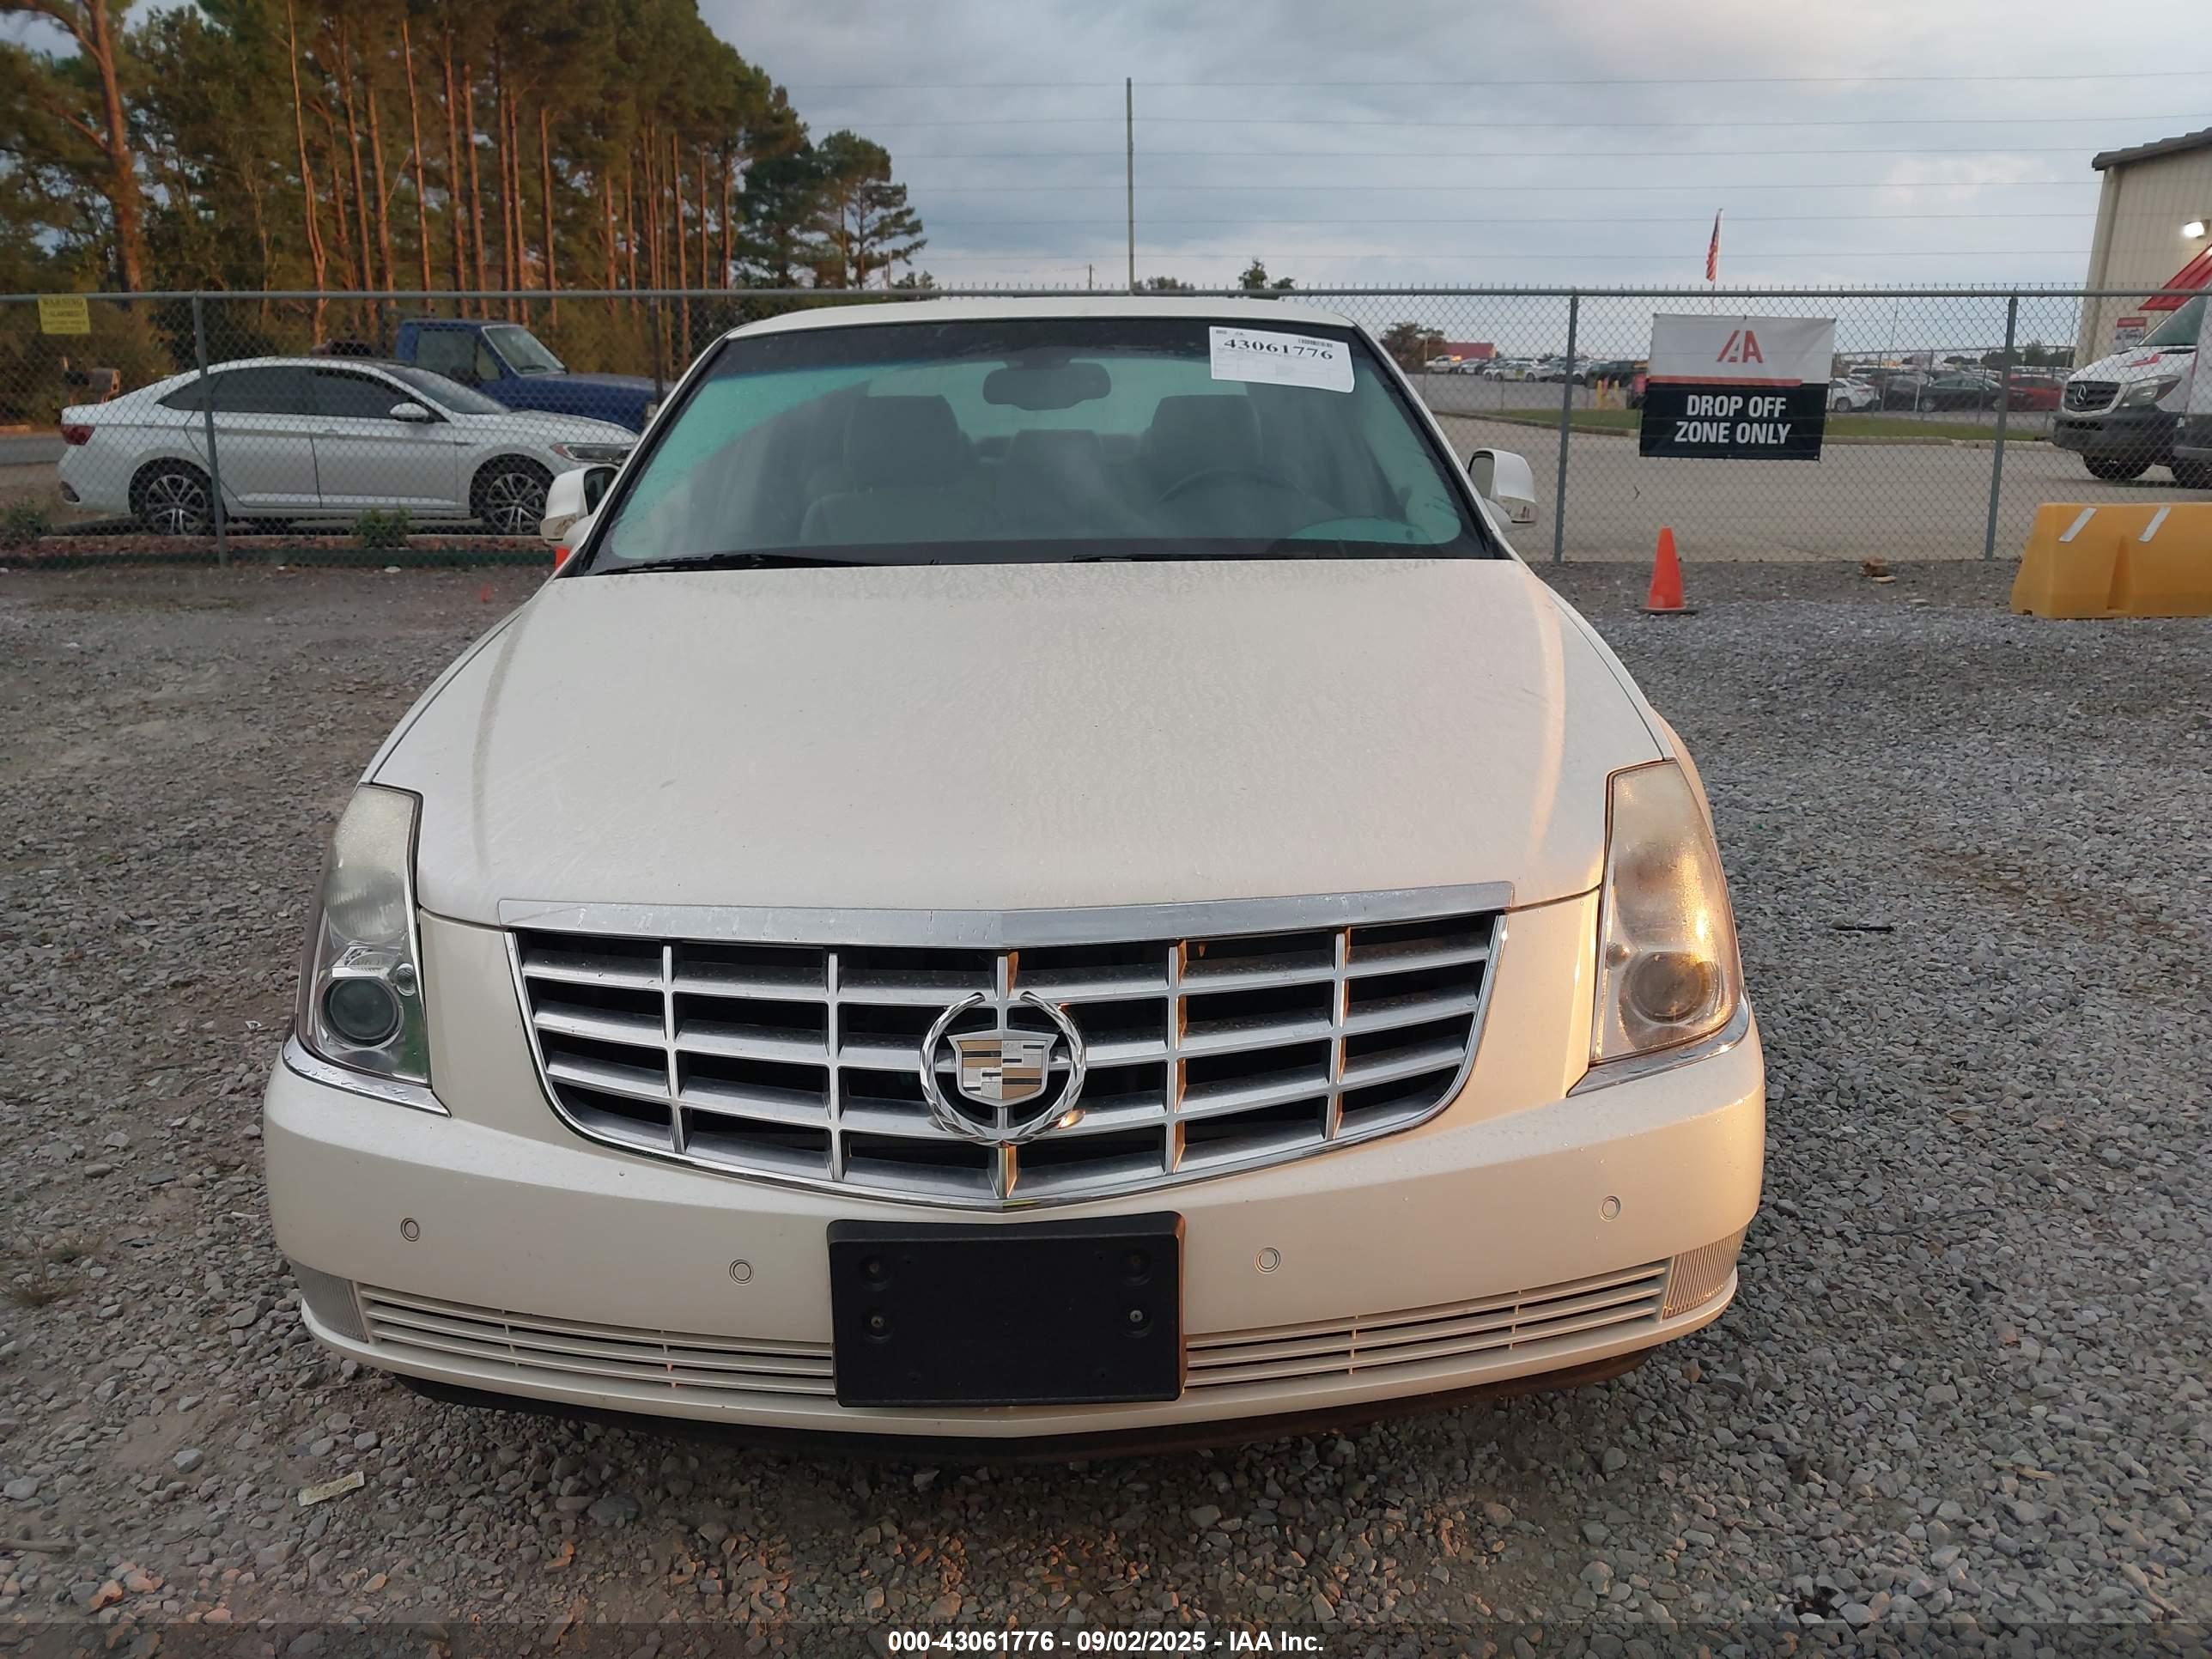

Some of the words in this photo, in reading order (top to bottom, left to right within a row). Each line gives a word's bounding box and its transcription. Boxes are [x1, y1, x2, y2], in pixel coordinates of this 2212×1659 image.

[1224, 338, 1333, 360] 43061776
[1686, 395, 1743, 417] DROP
[1748, 396, 1787, 418] OFF
[1674, 421, 1731, 444] ZONE
[1735, 423, 1792, 445] ONLY
